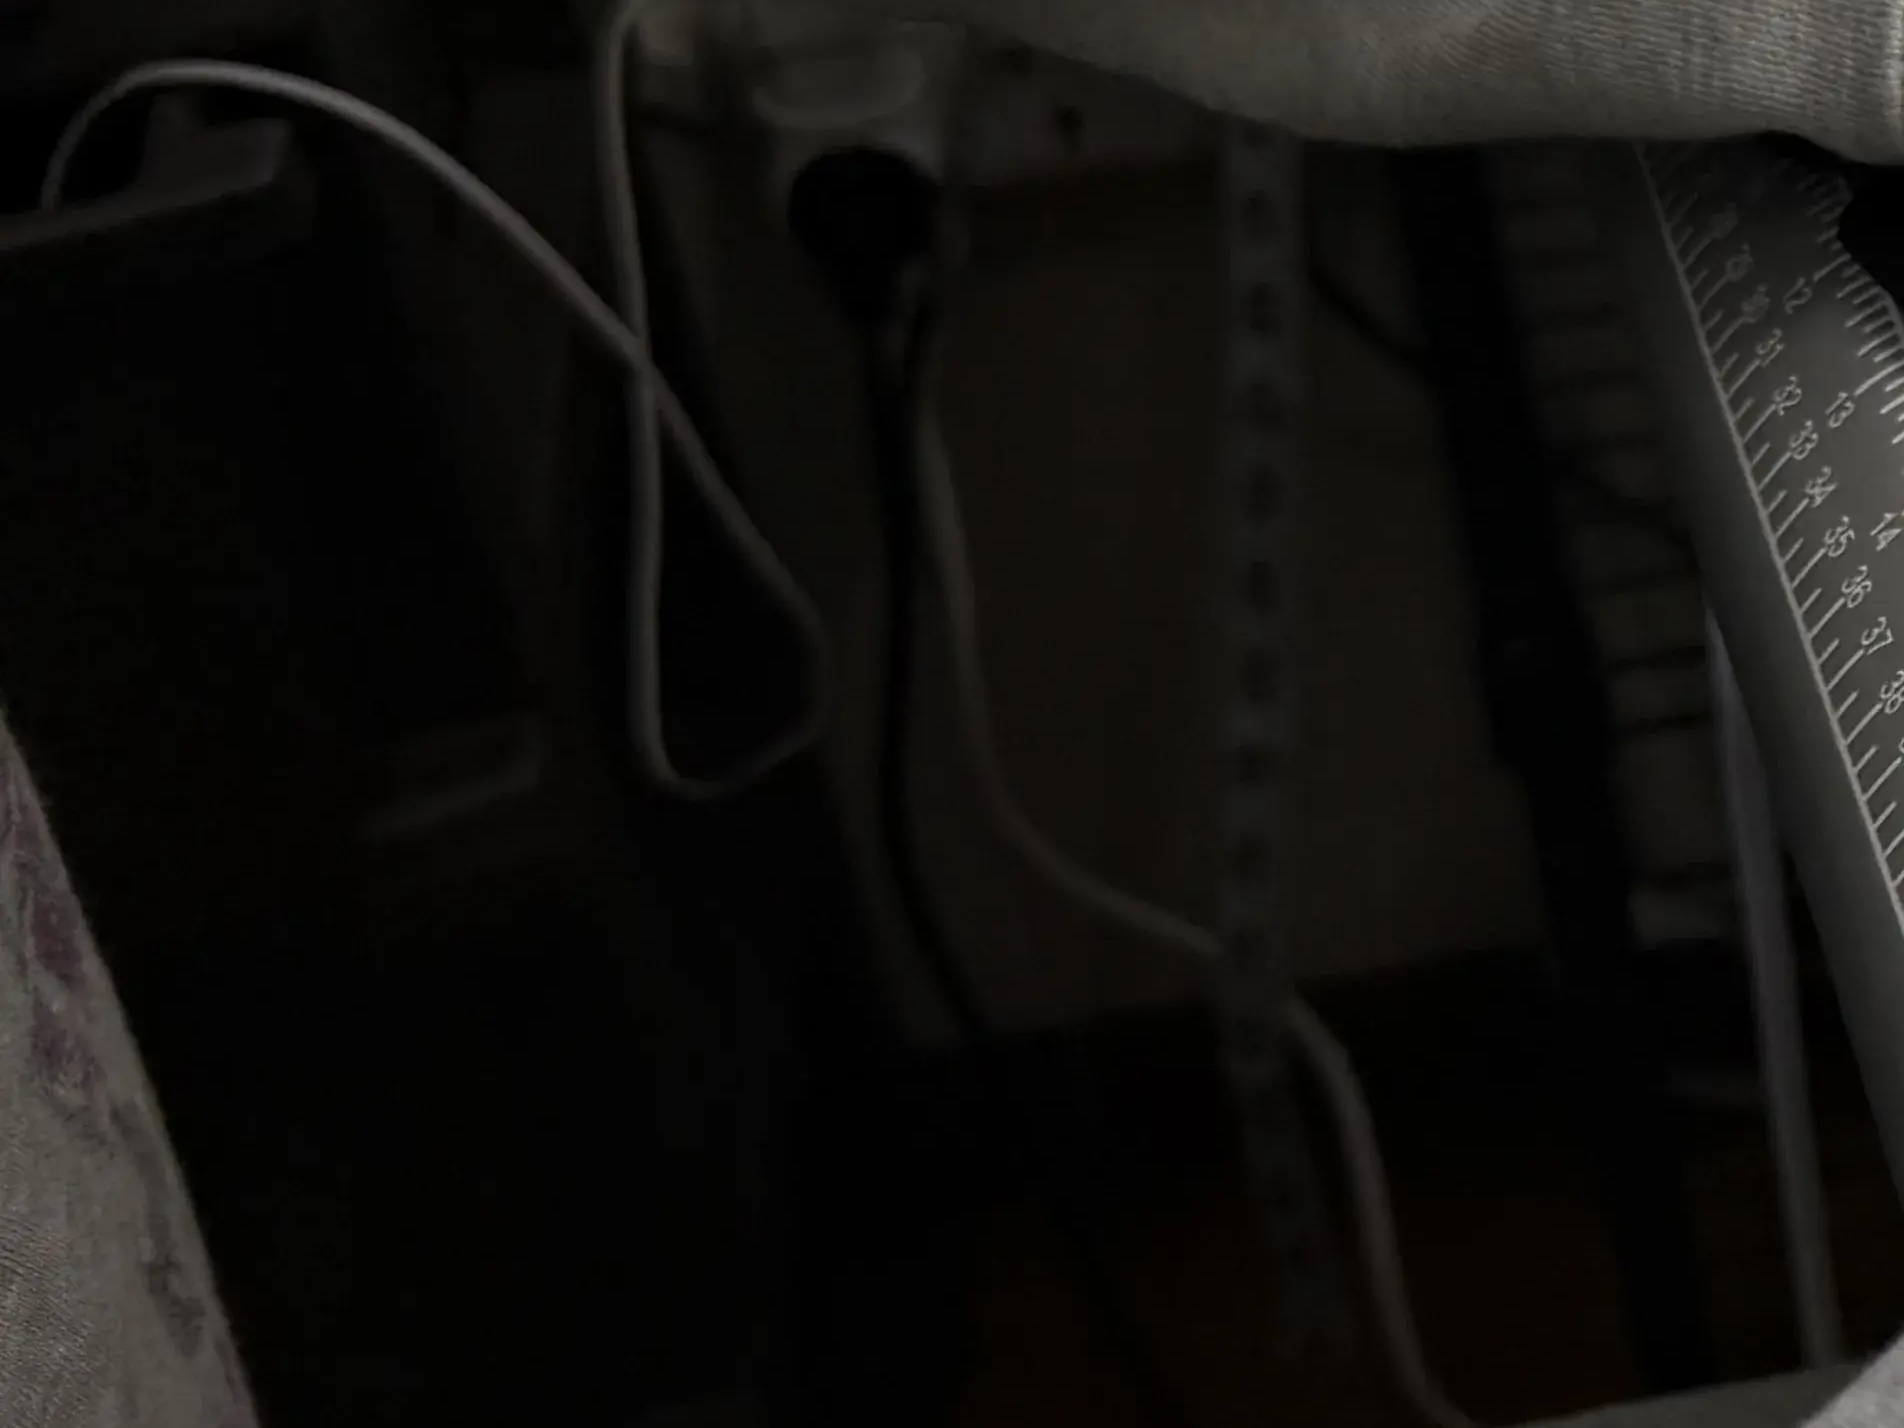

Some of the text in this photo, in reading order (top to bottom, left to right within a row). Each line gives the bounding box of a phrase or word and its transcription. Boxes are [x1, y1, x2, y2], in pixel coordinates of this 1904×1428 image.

[1782, 276, 1812, 314] 12
[1823, 391, 1856, 429] 13
[1789, 419, 1820, 460] 33
[1822, 514, 1856, 557] 35
[1869, 512, 1904, 552] 14
[1841, 564, 1873, 609] 36
[1860, 616, 1894, 656] 37
